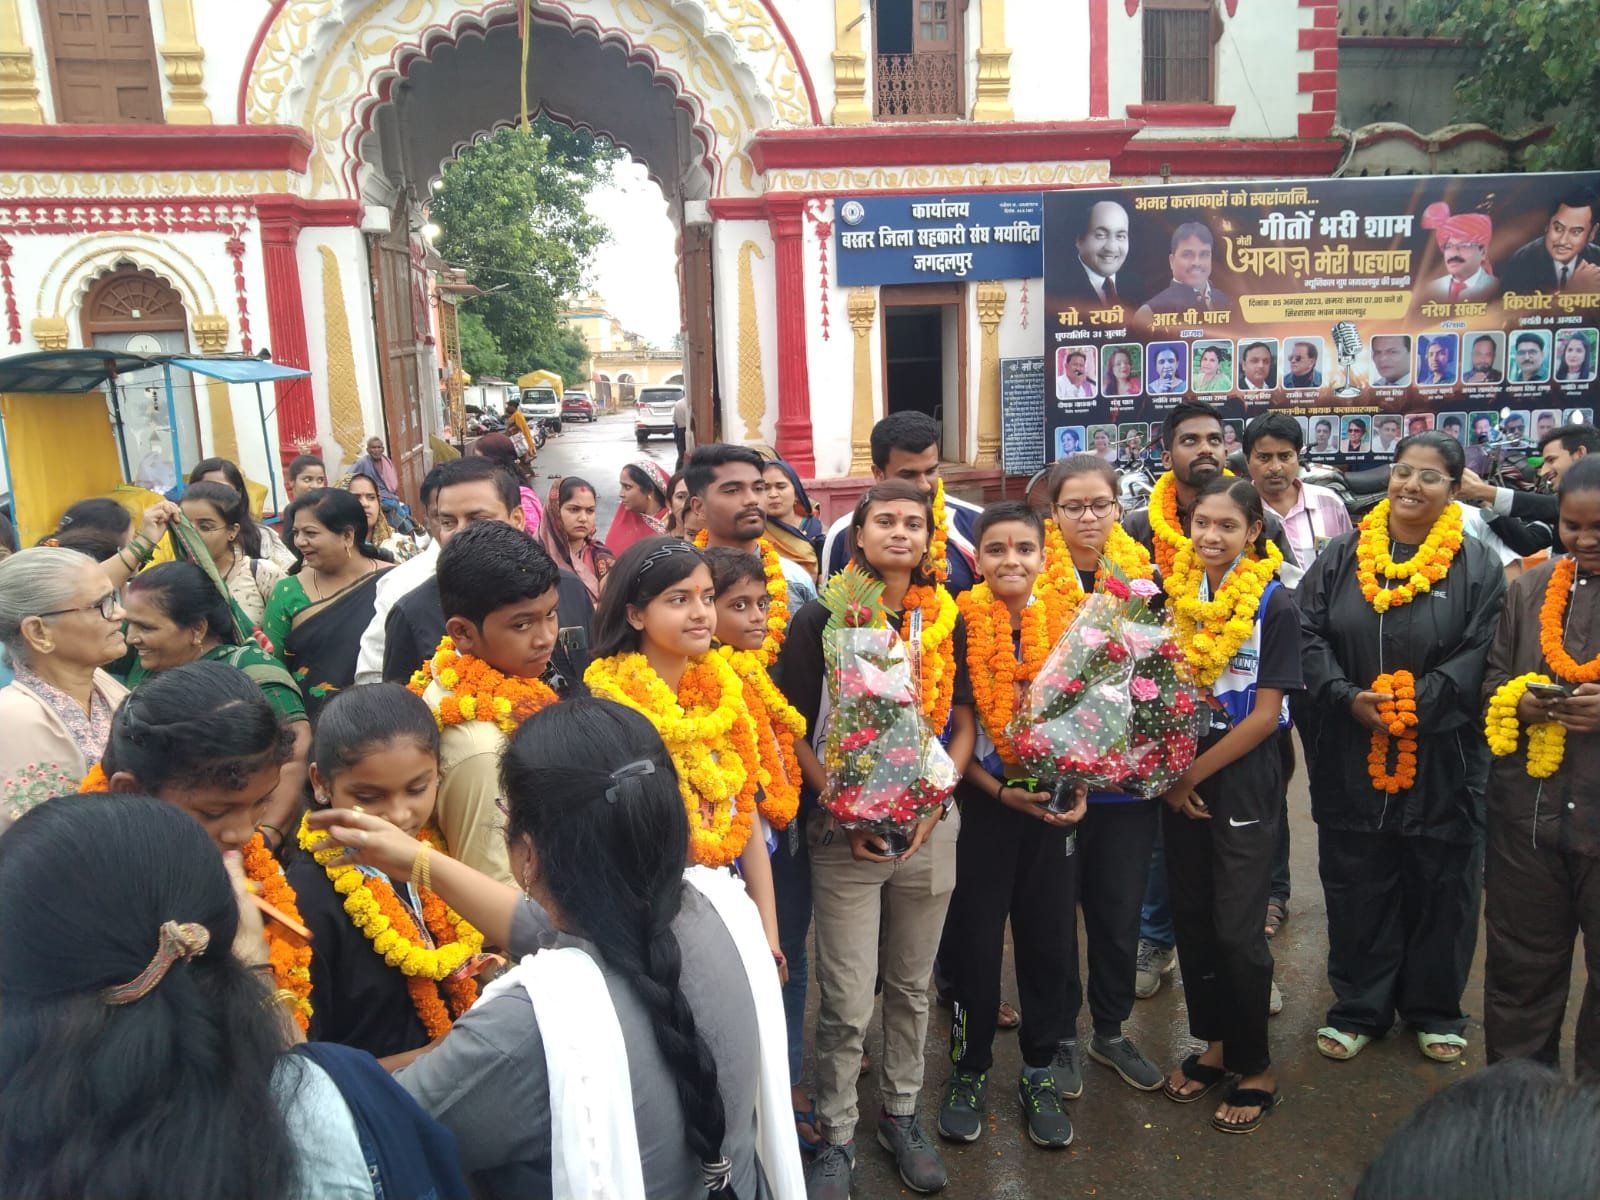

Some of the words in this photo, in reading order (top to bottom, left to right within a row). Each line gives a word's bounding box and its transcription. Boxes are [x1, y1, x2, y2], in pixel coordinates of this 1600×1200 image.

[912, 198, 970, 219] कार्यालय
[1135, 195, 1168, 210] अमर
[1170, 190, 1228, 210] कलाकारों
[1231, 189, 1248, 208] को
[841, 229, 875, 249] बस्तर
[879, 226, 913, 247] जिला
[918, 223, 965, 247] सहकारी
[970, 223, 990, 244] संघ
[994, 221, 1040, 244] मर्यादित
[1259, 210, 1315, 241] गीतों
[1320, 210, 1359, 239] भरी
[1364, 214, 1414, 238] शाम
[913, 253, 973, 276] जगदलपुर
[1315, 244, 1349, 275] मेरी
[1353, 249, 1410, 275] पहचान
[1421, 301, 1452, 317] नरेश
[1503, 291, 1553, 310] किशोर
[1558, 292, 1600, 312] कुमार
[1058, 308, 1083, 326] मो.
[1089, 305, 1124, 324] रफी
